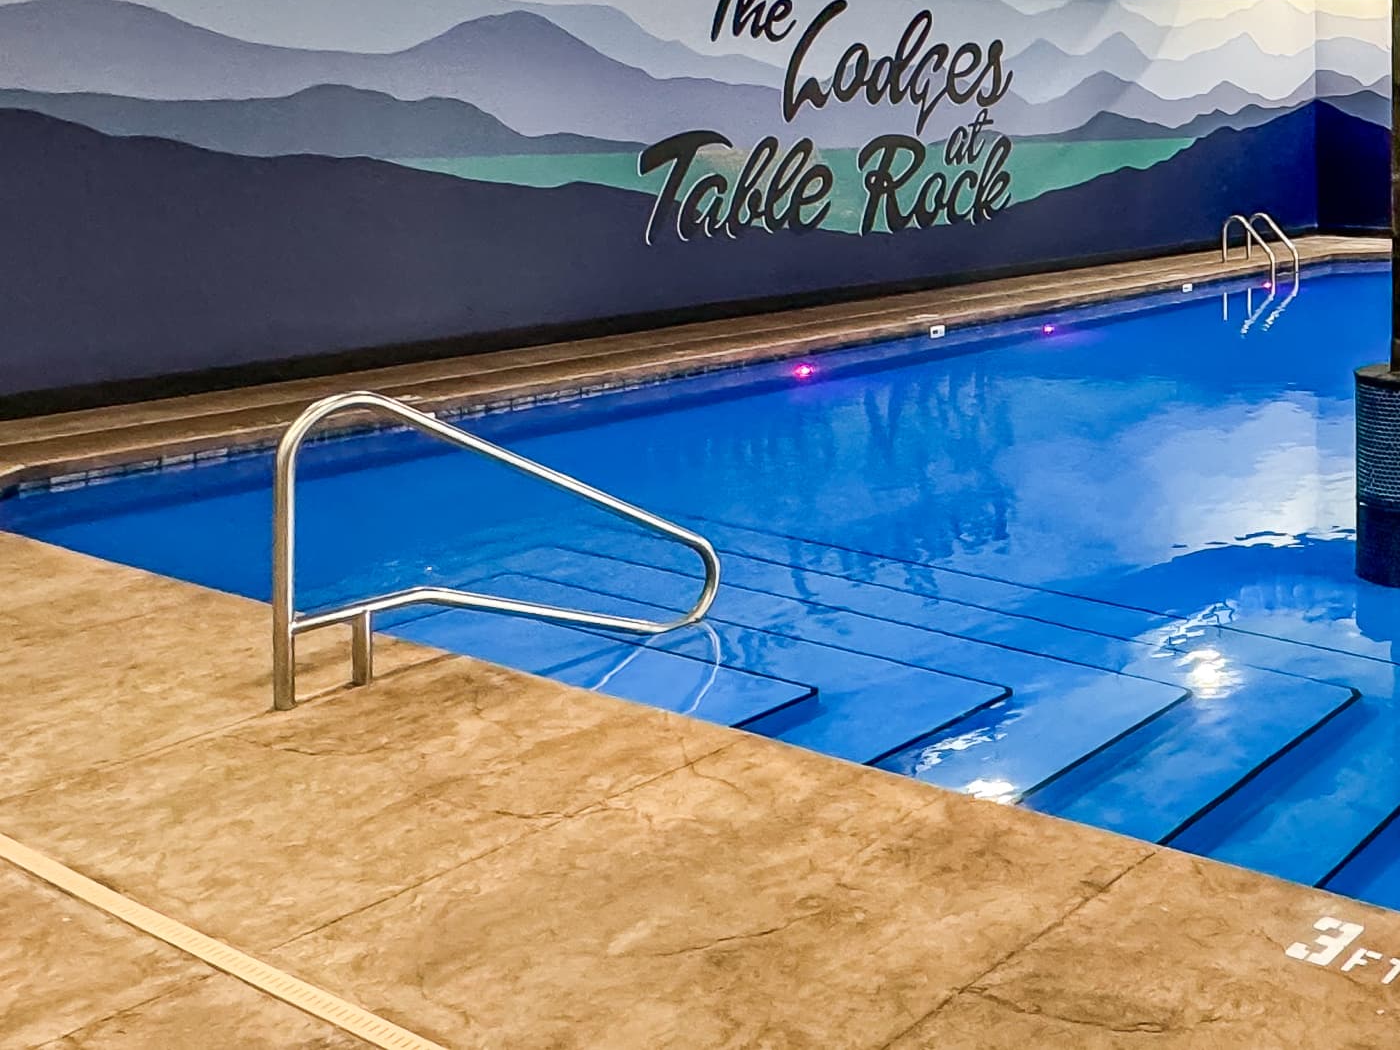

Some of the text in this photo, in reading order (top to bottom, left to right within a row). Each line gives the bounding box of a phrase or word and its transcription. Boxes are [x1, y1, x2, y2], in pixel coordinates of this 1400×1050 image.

[944, 108, 994, 167] at
[638, 130, 1012, 245] Table Rock
[1284, 916, 1364, 966] 3
